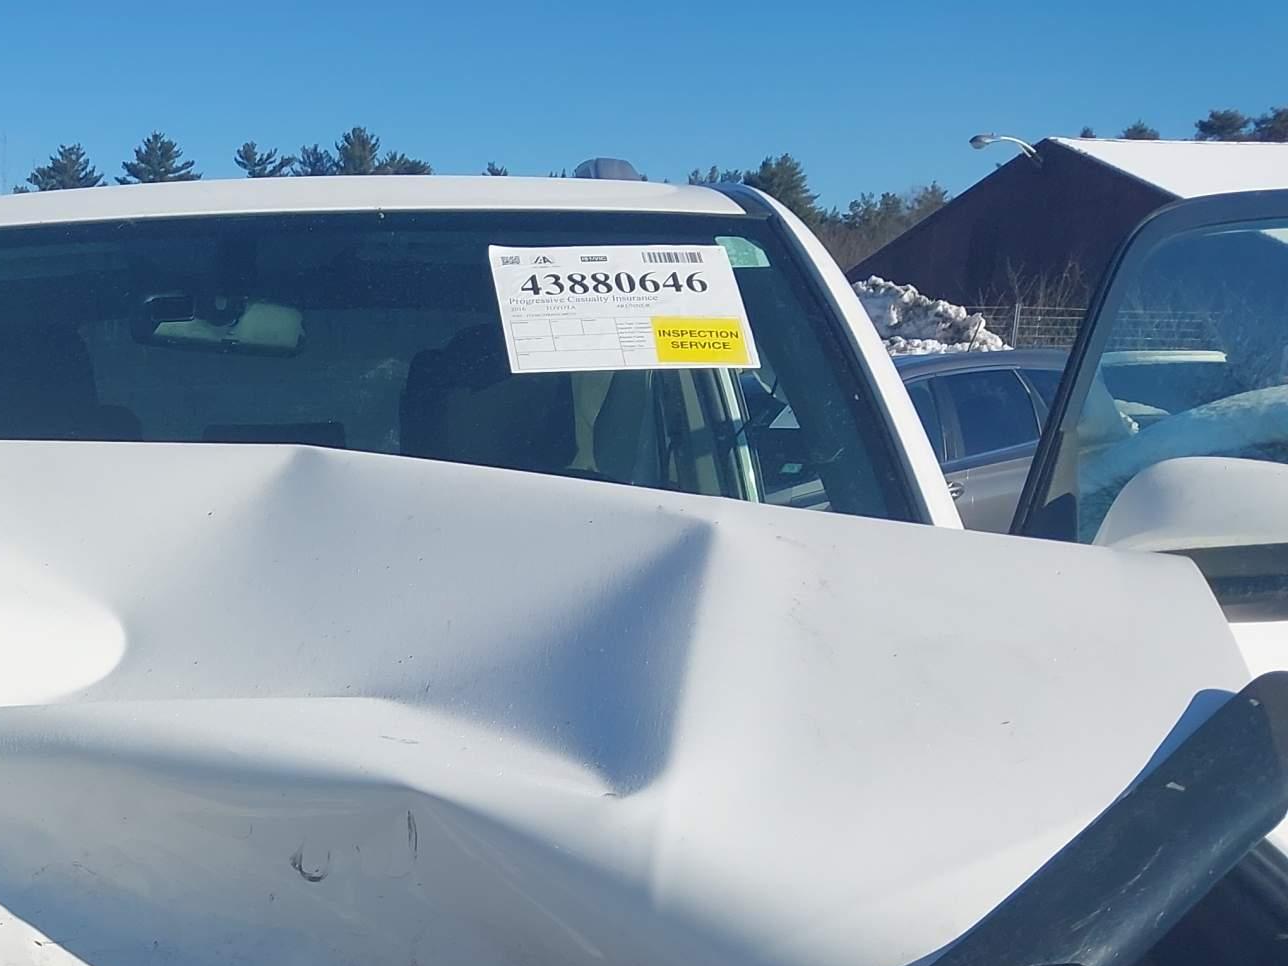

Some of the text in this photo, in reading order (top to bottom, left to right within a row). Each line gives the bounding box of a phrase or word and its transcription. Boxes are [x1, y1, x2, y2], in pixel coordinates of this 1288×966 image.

[521, 271, 708, 296] 43880646
[509, 294, 658, 306] Progressive Casualty Insurance
[657, 329, 739, 339] INSPECTION
[670, 340, 733, 350] SERVICE
